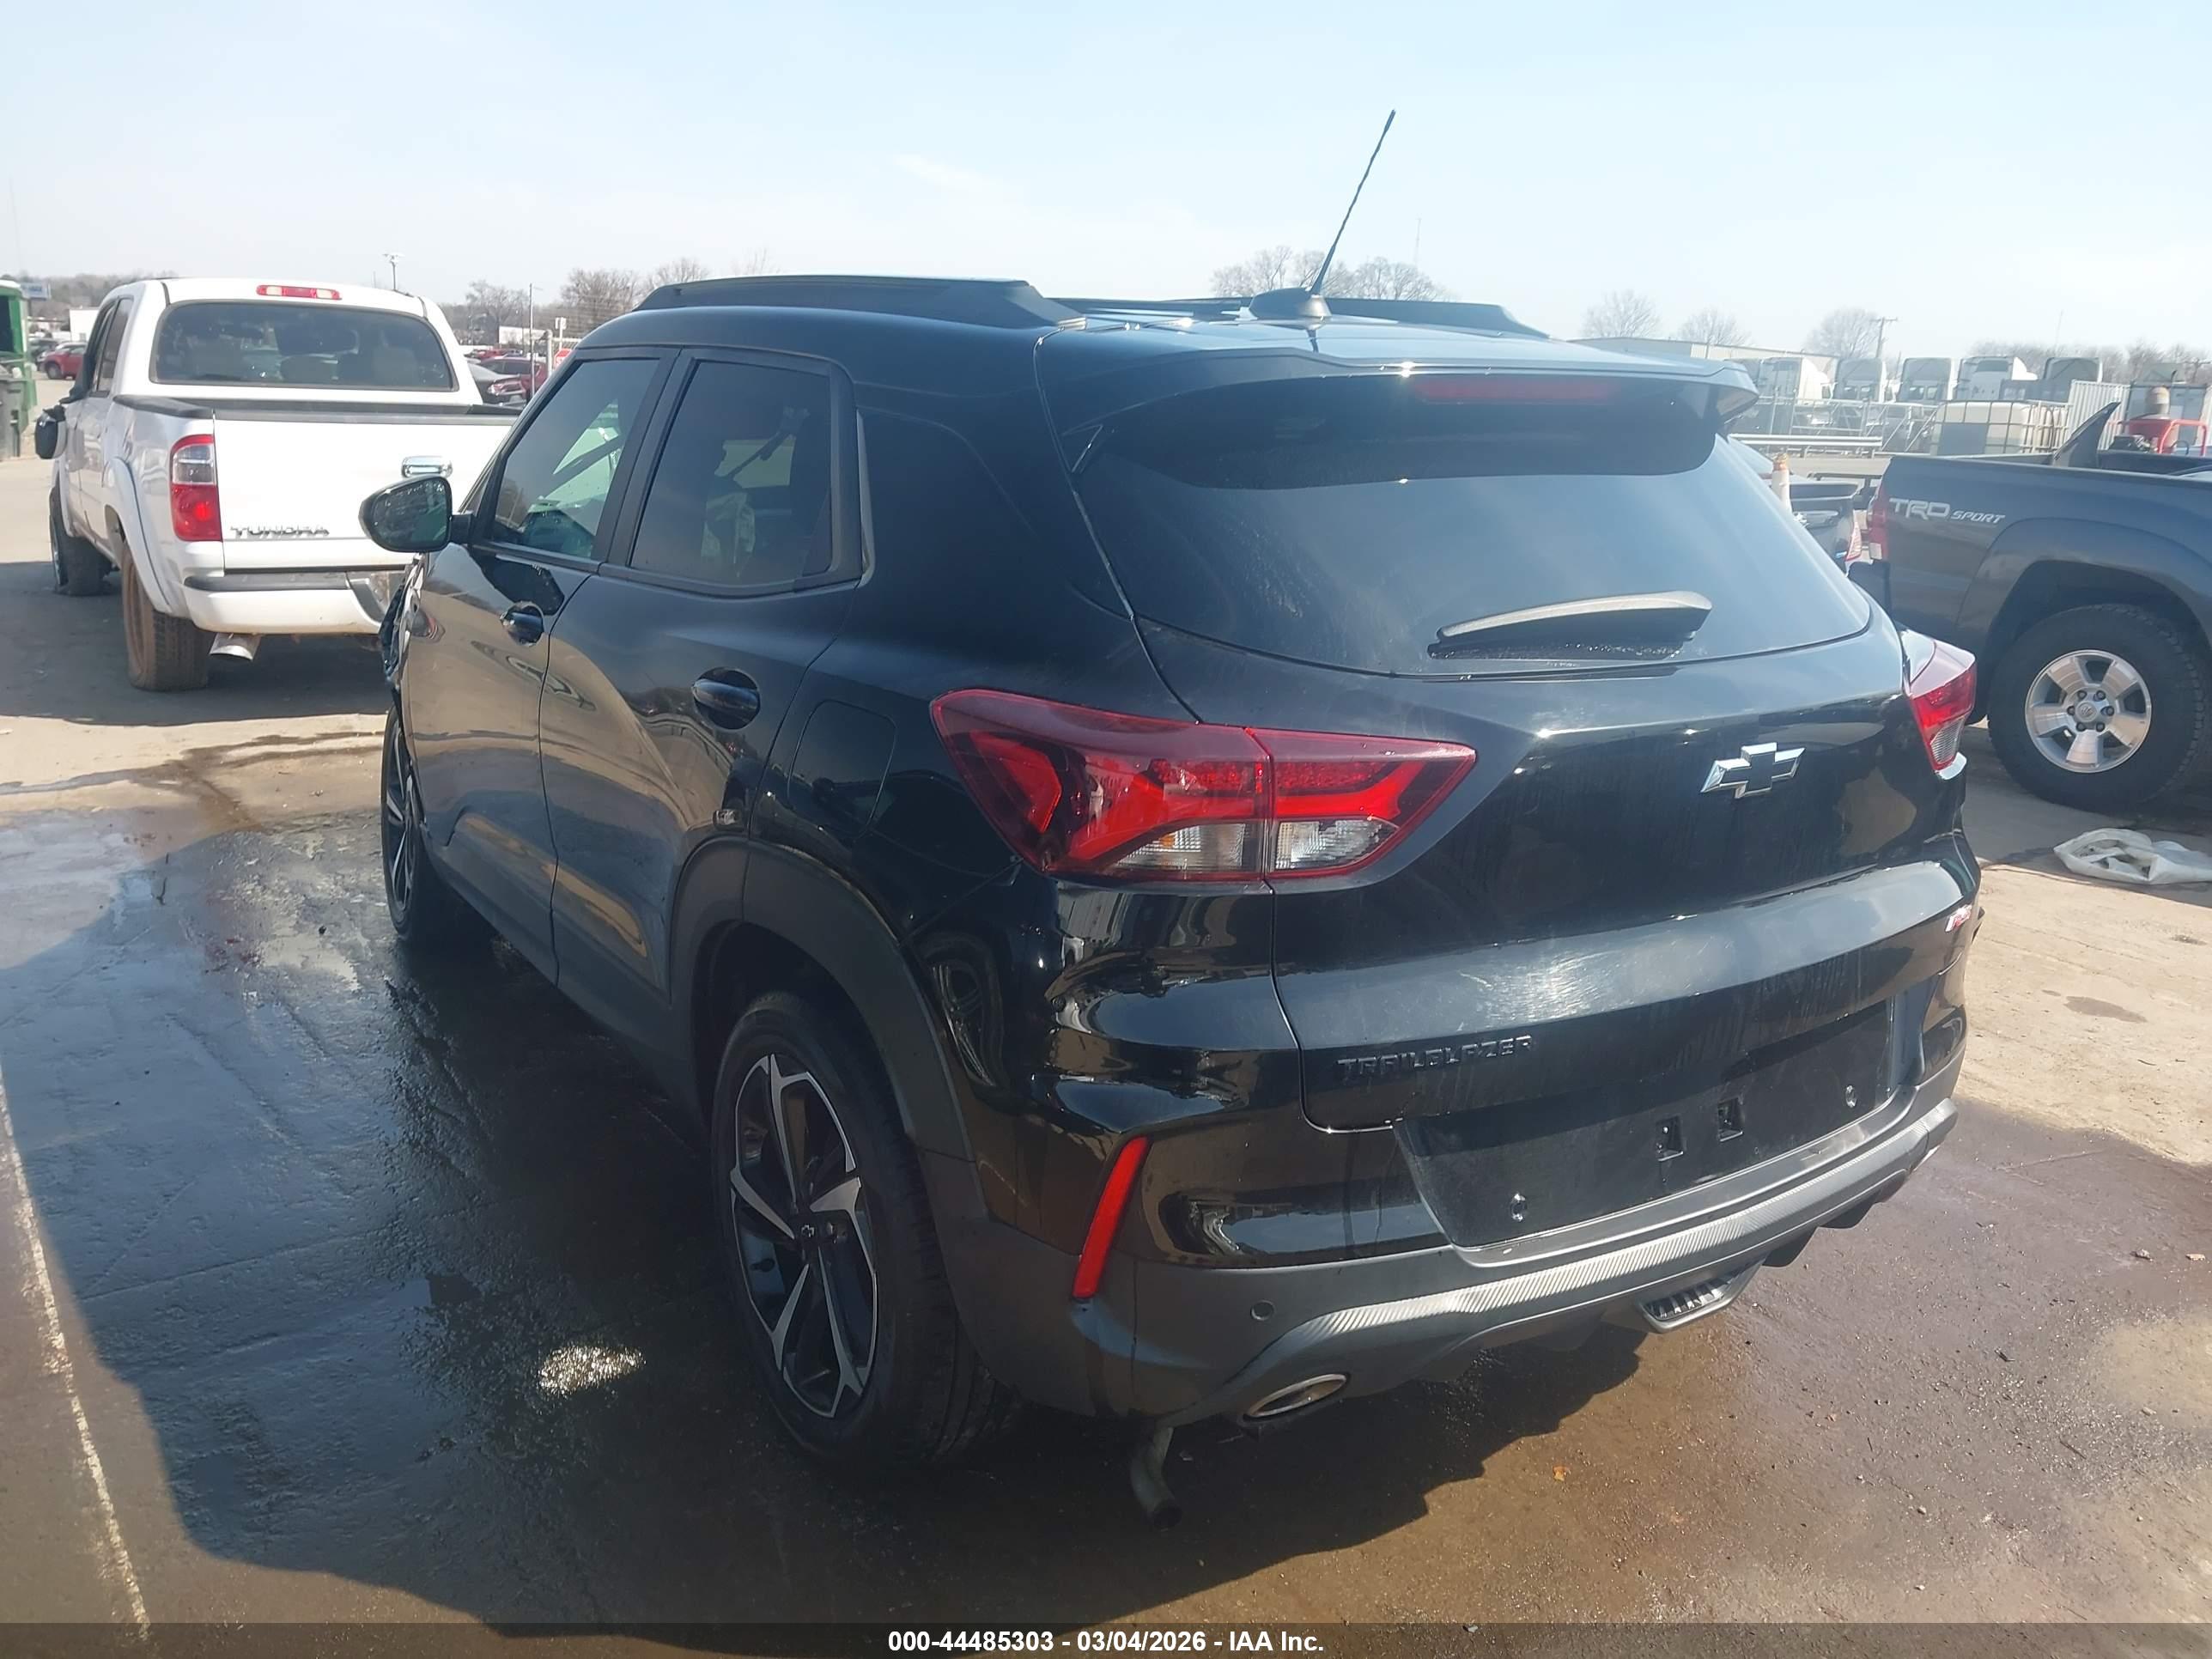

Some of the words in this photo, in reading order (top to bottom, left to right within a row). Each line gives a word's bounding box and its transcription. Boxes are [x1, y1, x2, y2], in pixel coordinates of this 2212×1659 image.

[1889, 497, 1951, 520] TRD
[1950, 510, 2006, 524] SPORT
[230, 526, 330, 538] TUNDRA
[1337, 1034, 1533, 1076] TRAILBLAZER
